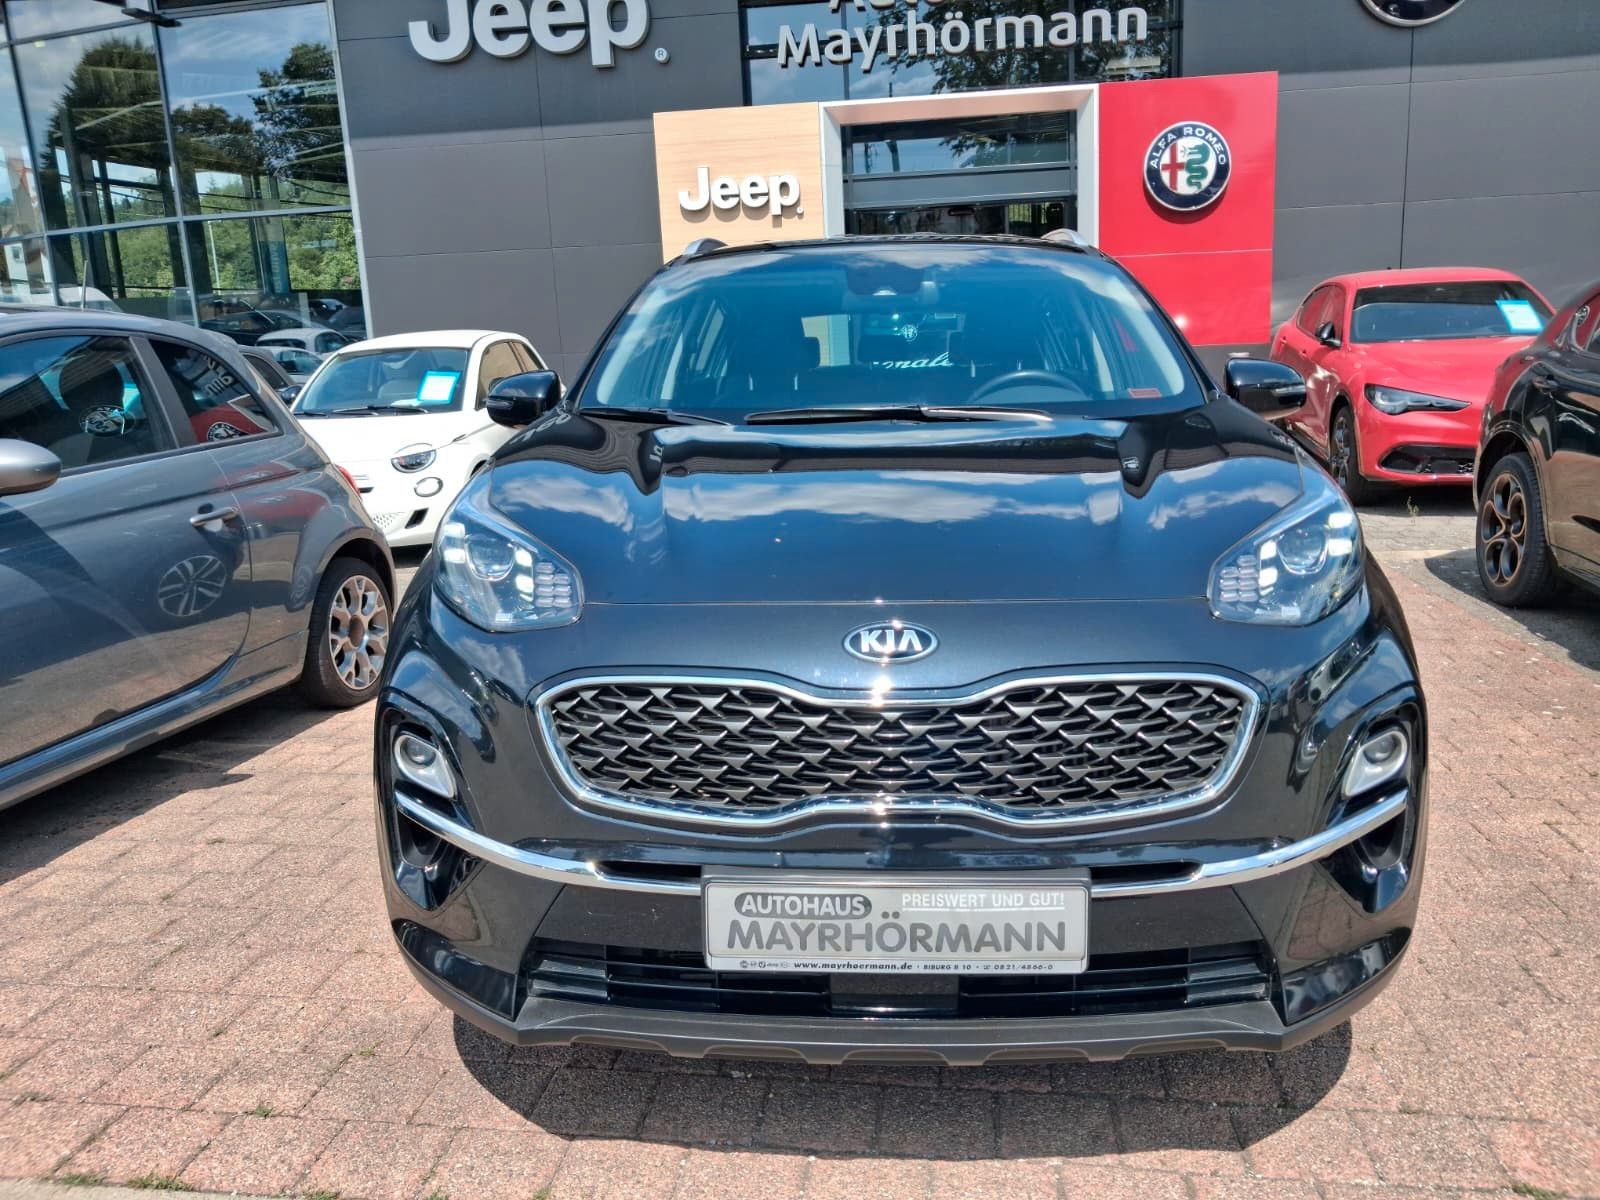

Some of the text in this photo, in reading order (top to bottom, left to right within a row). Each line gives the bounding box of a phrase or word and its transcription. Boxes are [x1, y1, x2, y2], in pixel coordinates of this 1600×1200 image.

[408, 0, 652, 68] Jeep
[776, 6, 1149, 71] Mayrhörmann
[1149, 126, 1227, 169] ALFA ROMEO
[677, 166, 801, 216] Jeep
[859, 629, 924, 653] KIA
[741, 894, 866, 916] AUTOHAUS
[902, 892, 1065, 908] PREISWERT UND GUT!
[727, 911, 1066, 953] MAYRHÖRMANN
[793, 961, 913, 971] www.mayrhoermann.de
